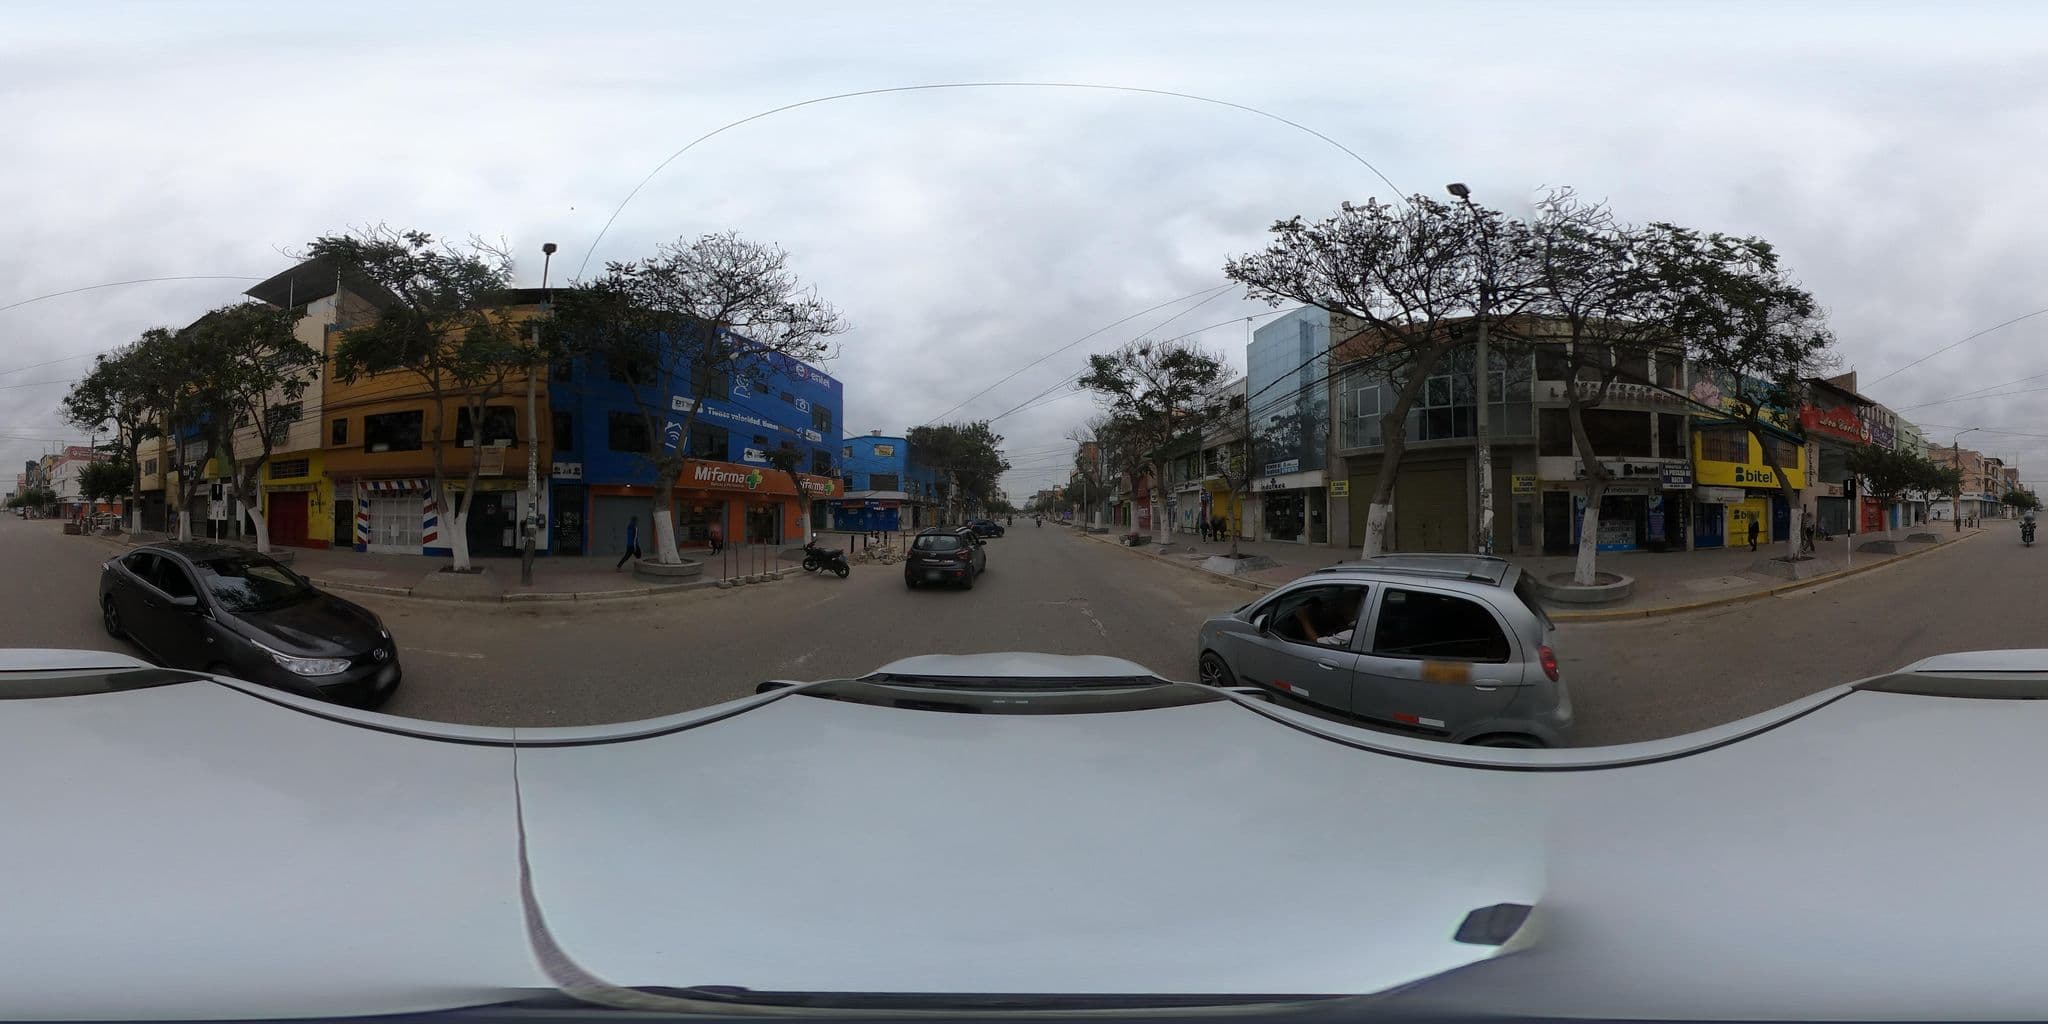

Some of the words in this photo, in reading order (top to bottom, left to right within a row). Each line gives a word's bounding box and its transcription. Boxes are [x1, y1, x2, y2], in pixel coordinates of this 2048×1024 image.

[810, 372, 830, 388] entel
[706, 406, 730, 419] Tienes
[694, 465, 745, 483] Mifarma
[1746, 469, 1773, 483] bitel
